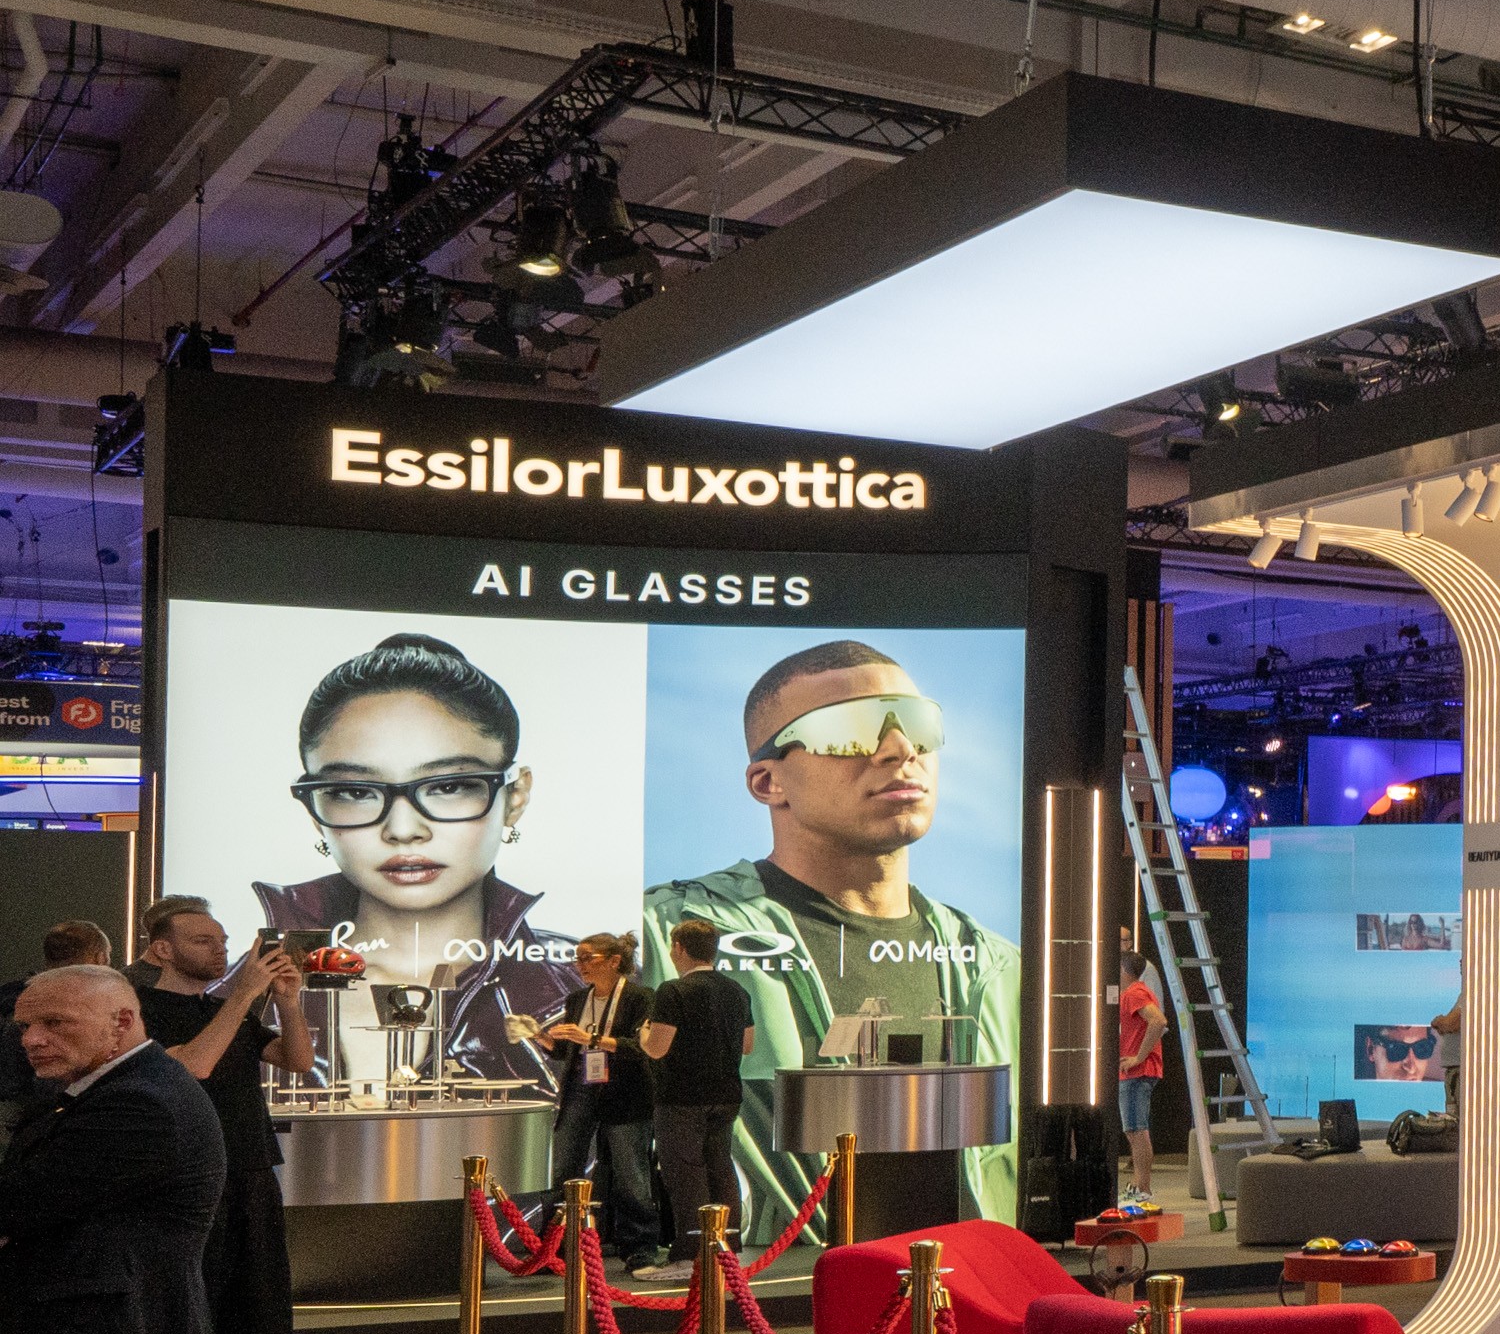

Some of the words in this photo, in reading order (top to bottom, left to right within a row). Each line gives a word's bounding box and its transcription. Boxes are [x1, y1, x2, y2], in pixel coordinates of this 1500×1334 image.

[331, 428, 926, 509] EssilorLuxottica
[471, 564, 531, 597] AI
[562, 569, 812, 607] GLASSES
[0, 711, 50, 726] from
[715, 958, 813, 972] AKLEY
[908, 940, 977, 963] Meta
